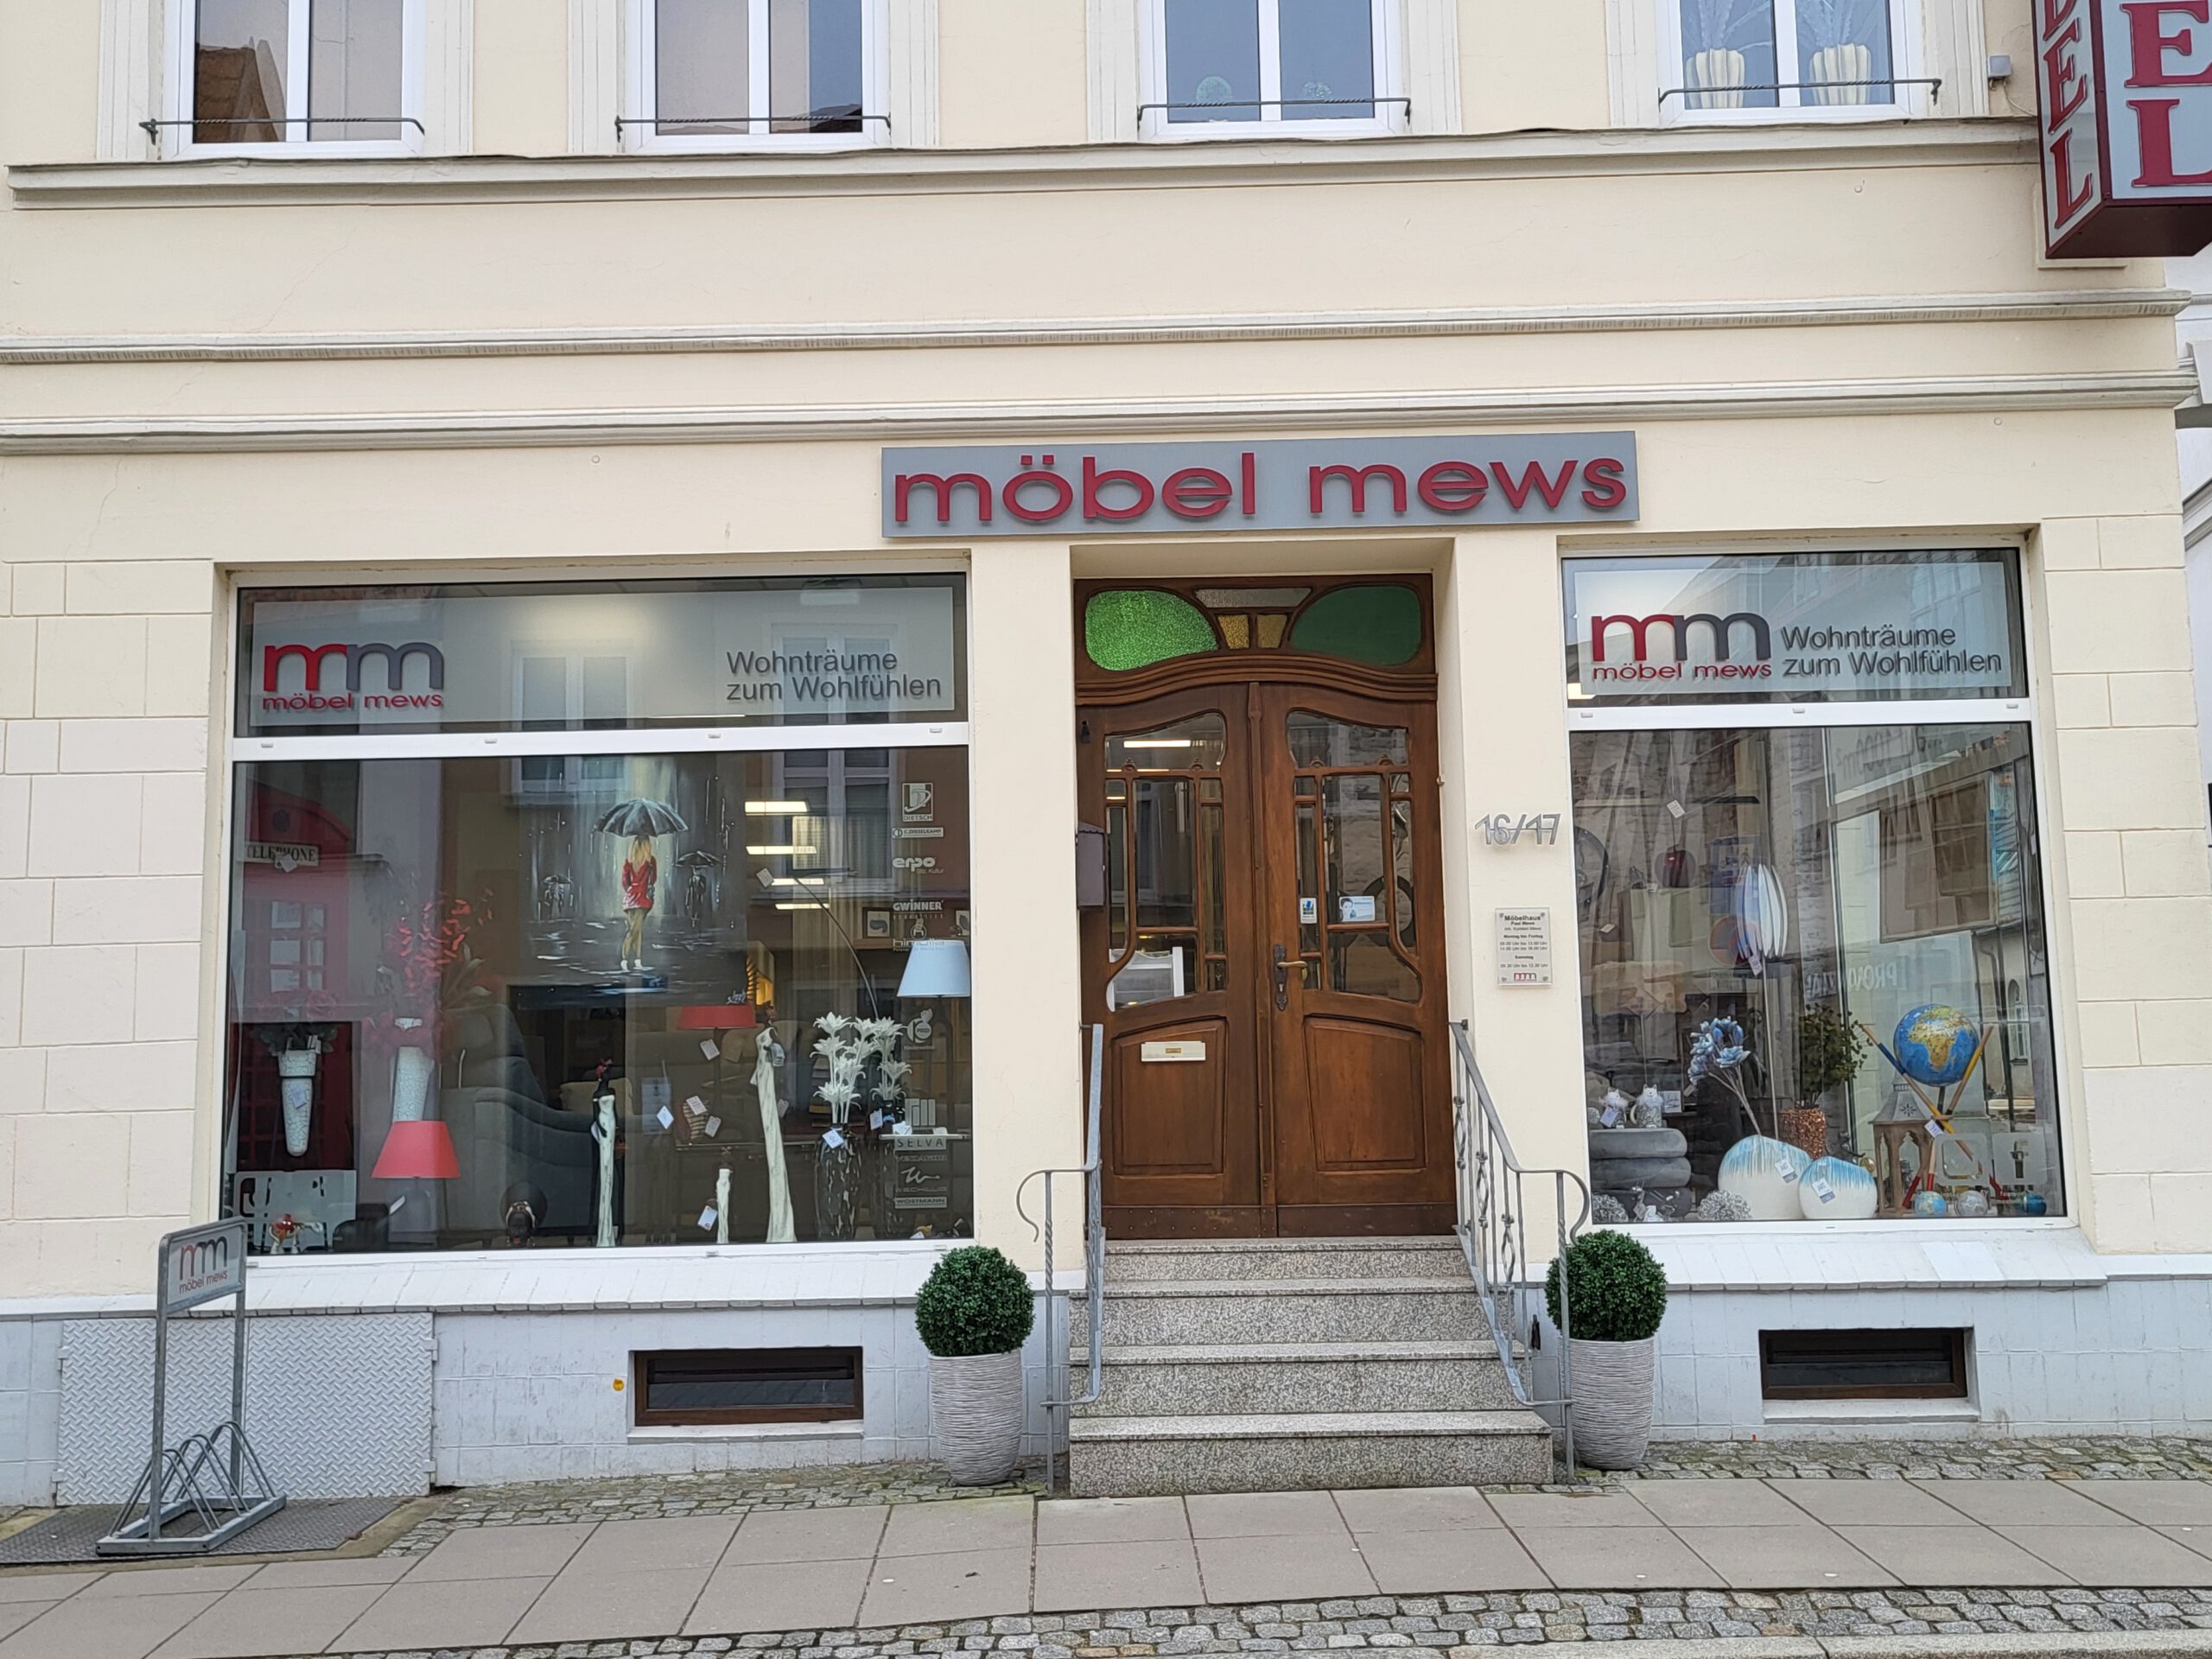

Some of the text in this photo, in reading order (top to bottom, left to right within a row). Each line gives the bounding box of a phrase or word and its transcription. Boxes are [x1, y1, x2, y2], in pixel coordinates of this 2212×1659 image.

[894, 451, 1627, 523] möbel mews
[1591, 612, 1771, 663] mm
[1782, 624, 1956, 651] Wohnträume
[263, 642, 444, 692] mm
[726, 649, 898, 675] Wohnträume
[1592, 662, 1772, 680] möbel mews
[1783, 652, 2002, 677] zum Wohlfühlen
[262, 692, 444, 710] möbel mews
[726, 674, 942, 702] zum Wohlfühlen
[1474, 813, 1561, 845] 16/17
[892, 857, 936, 872] erpo
[897, 1138, 944, 1147] SELVA
[207, 1270, 228, 1285] mews
